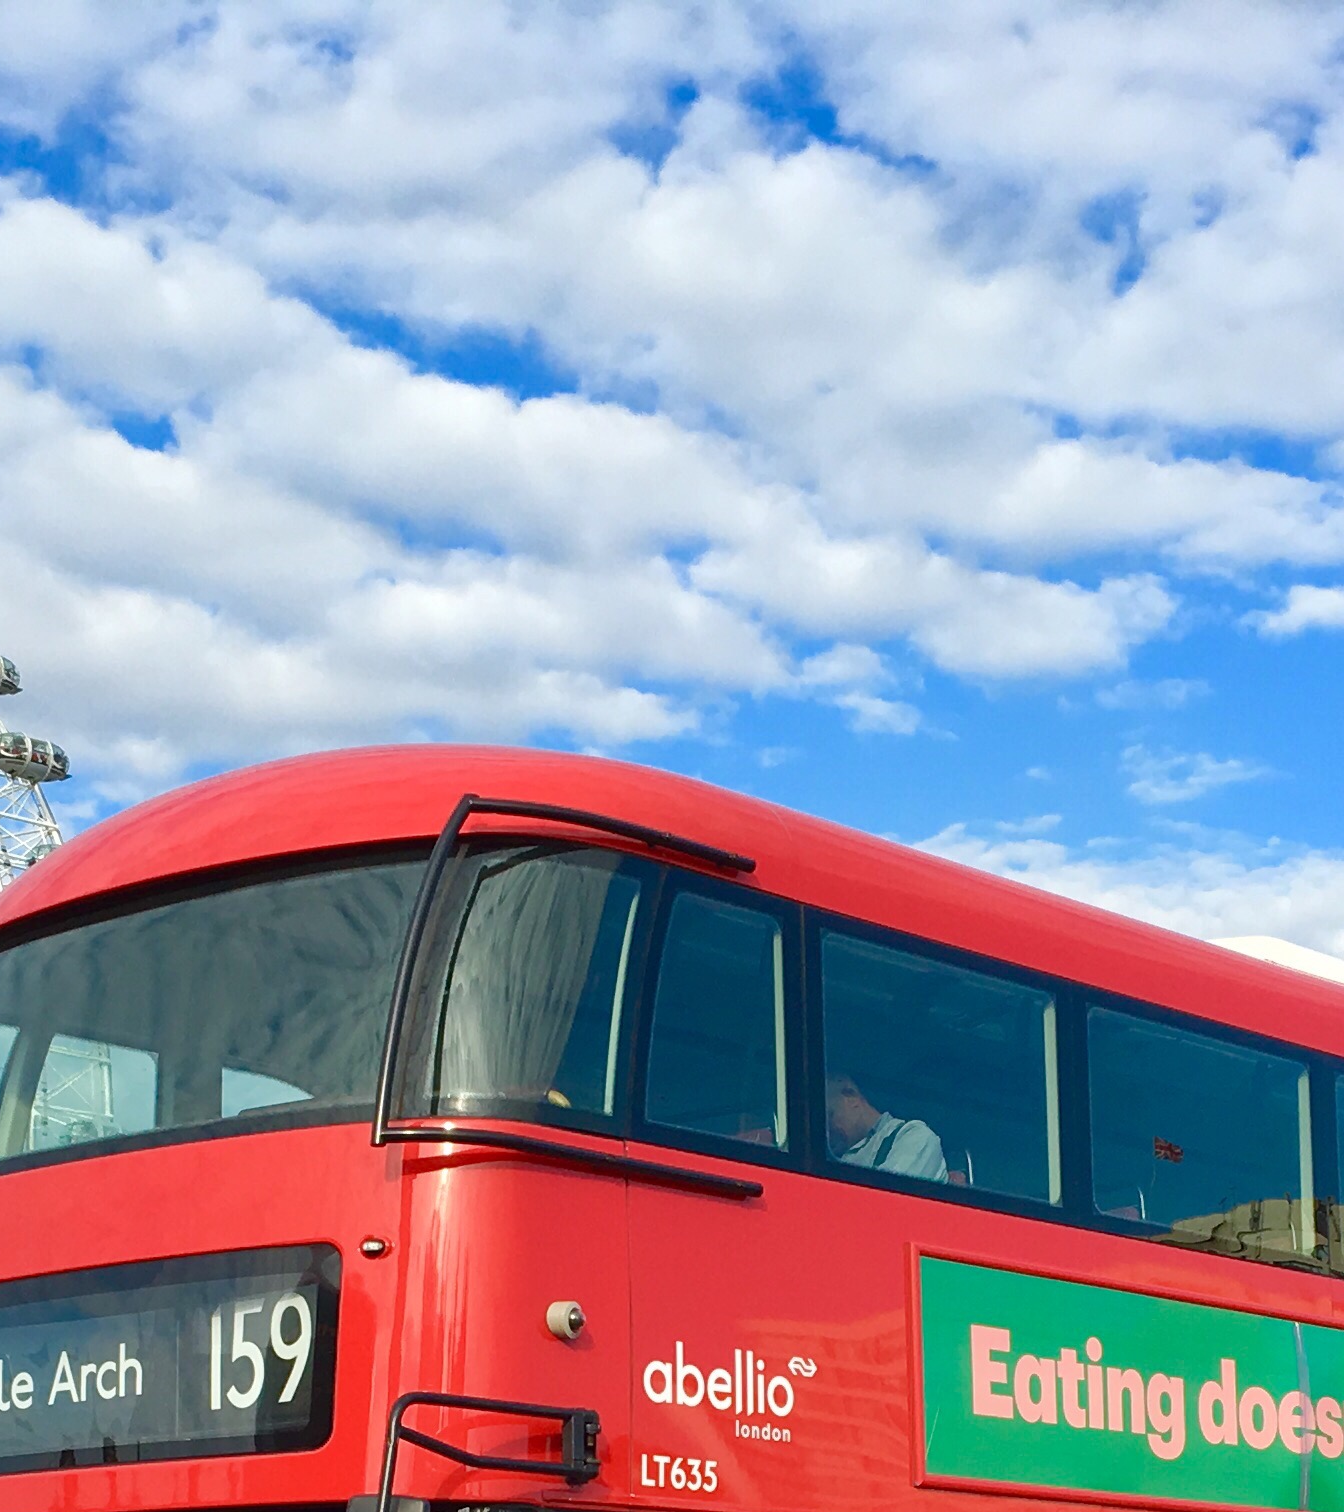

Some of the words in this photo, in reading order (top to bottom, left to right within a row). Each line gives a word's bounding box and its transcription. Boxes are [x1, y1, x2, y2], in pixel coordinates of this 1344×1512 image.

[47, 1342, 143, 1406] Arch
[210, 1293, 312, 1411] 159
[643, 1340, 794, 1417] abellio
[970, 1324, 1186, 1460] Eating
[735, 1419, 791, 1443] london
[641, 1453, 718, 1493] LT635
